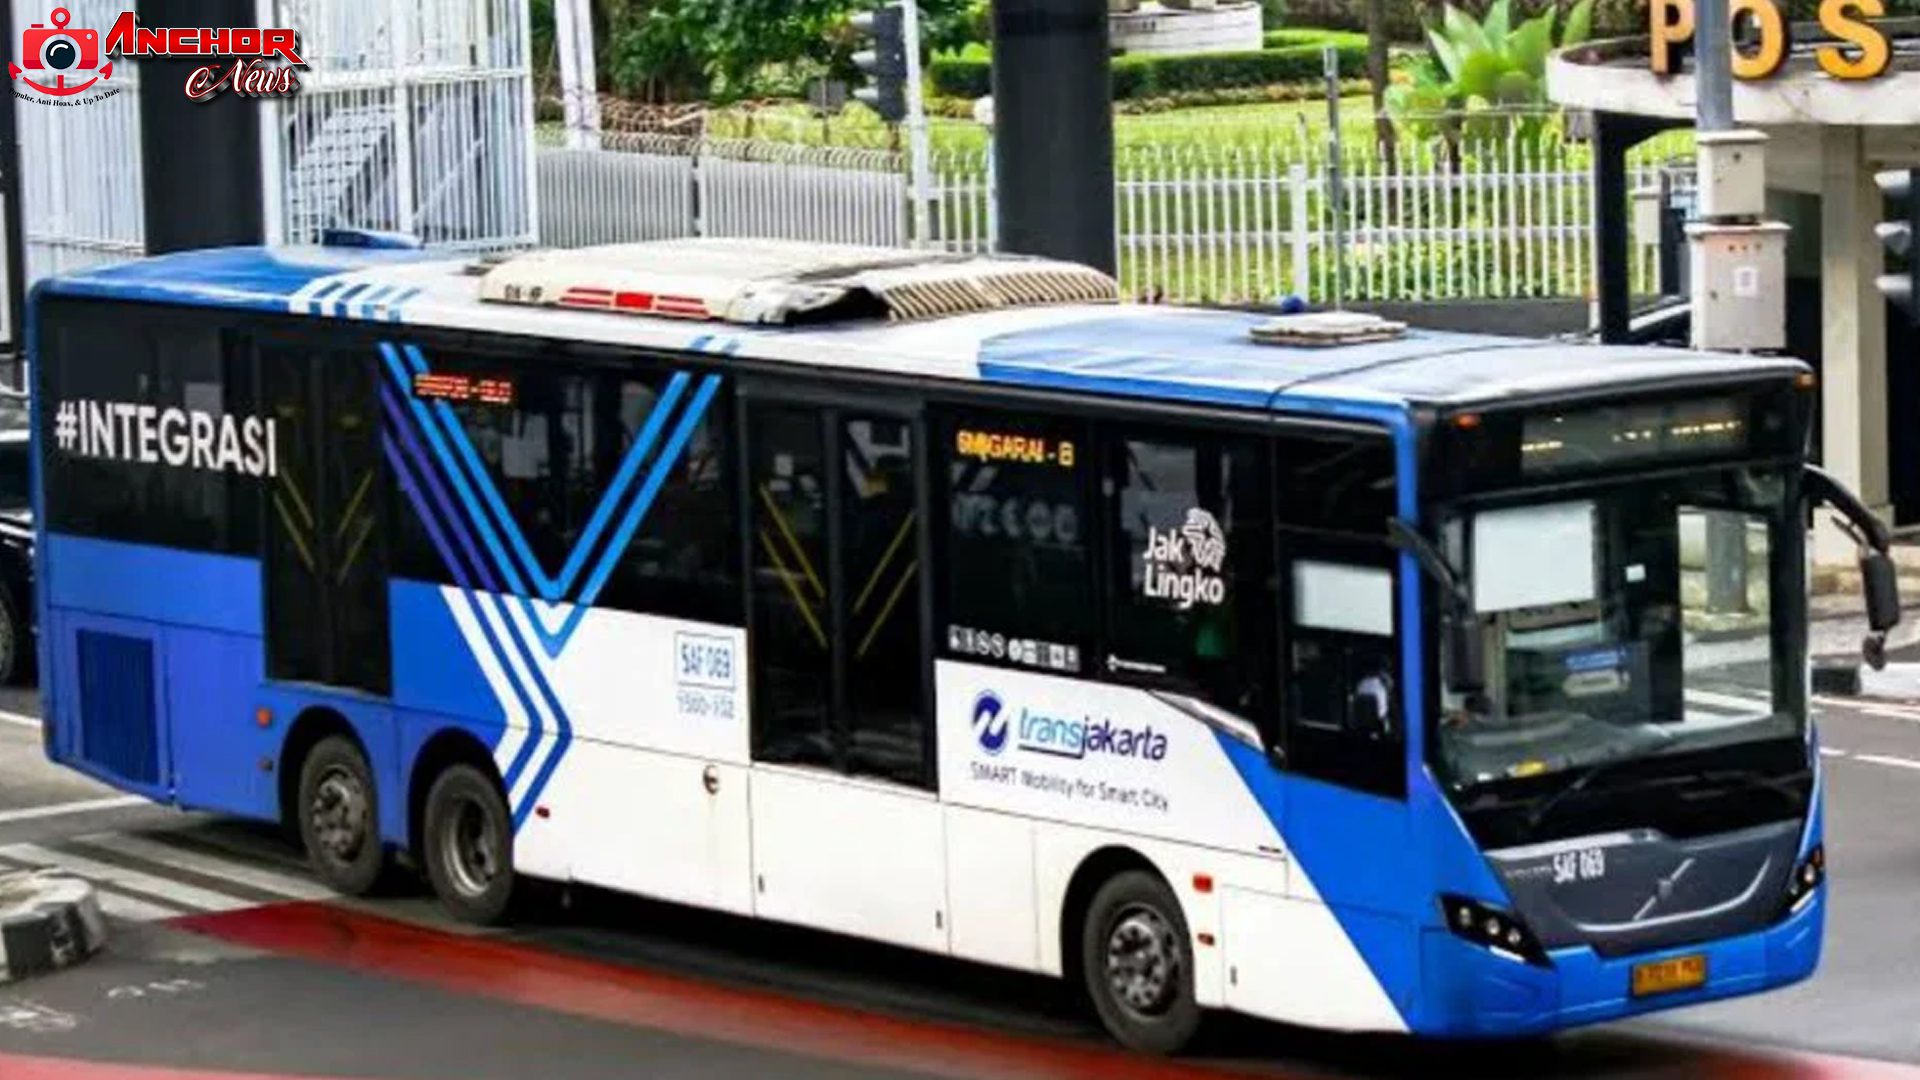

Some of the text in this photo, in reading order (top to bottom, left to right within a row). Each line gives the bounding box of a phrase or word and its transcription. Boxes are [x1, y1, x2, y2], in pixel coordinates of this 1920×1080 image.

[1649, 0, 1893, 80] POS
[55, 399, 277, 477] #INTEGRASI
[1144, 526, 1184, 562] Jak
[1144, 564, 1225, 609] Lingko
[681, 641, 731, 679] SAF 069
[1018, 707, 1168, 762] transjakarta
[970, 761, 1017, 785] SMART
[1020, 770, 1074, 799] Mobility
[1075, 778, 1096, 799] for
